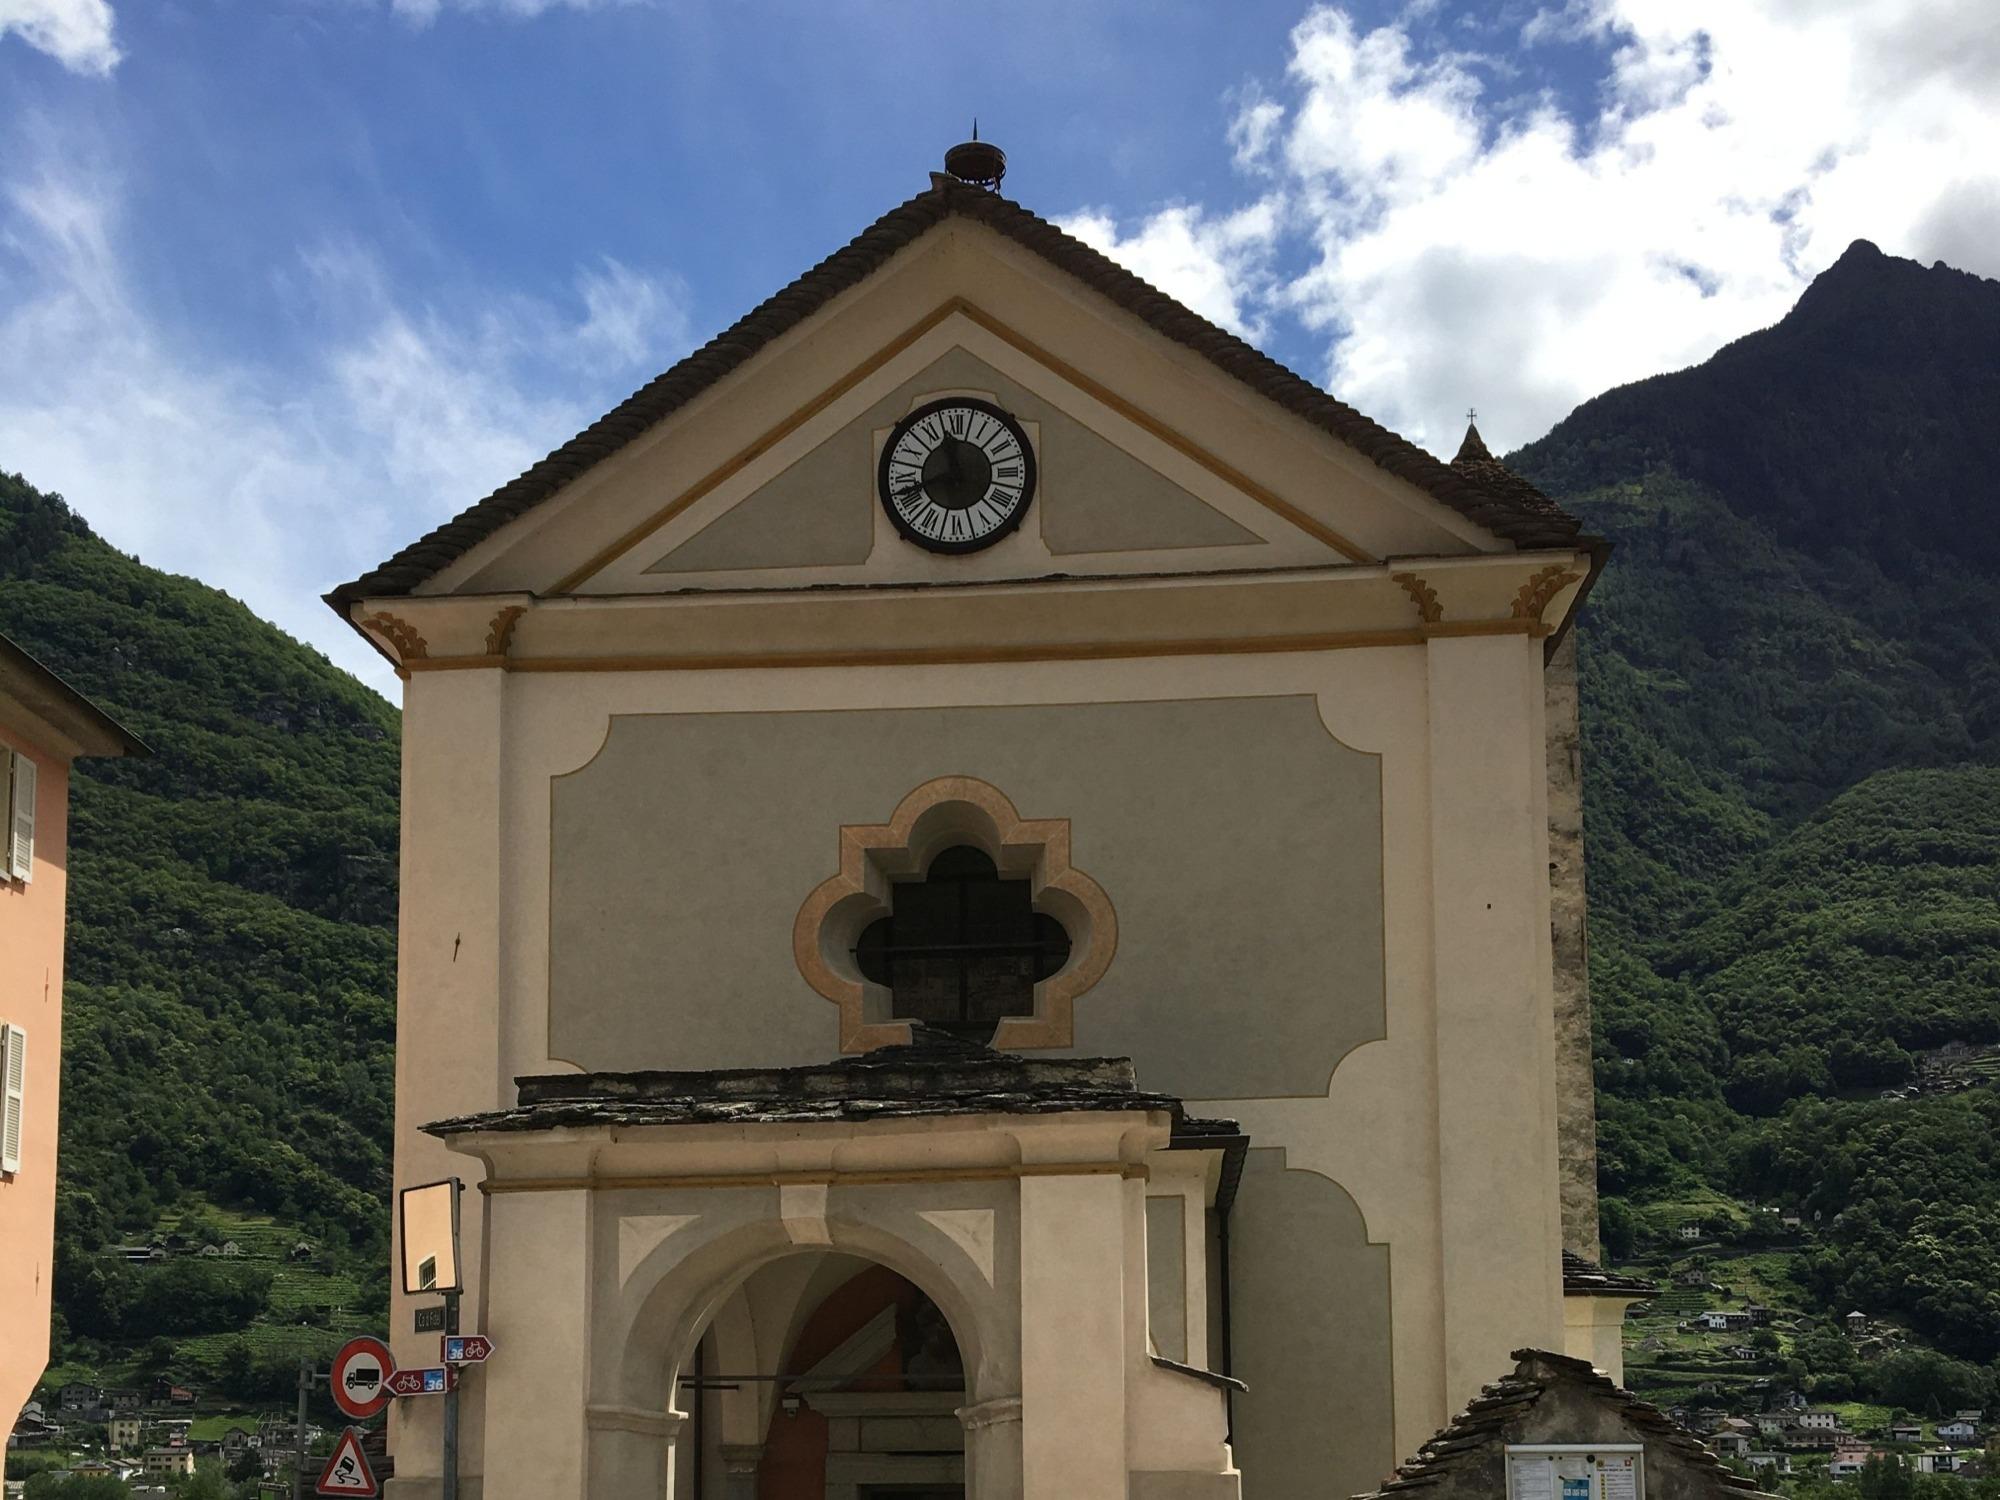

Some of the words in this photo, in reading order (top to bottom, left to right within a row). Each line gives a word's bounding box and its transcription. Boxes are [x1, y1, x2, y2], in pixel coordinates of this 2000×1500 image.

[997, 466, 1019, 478] III
[450, 1348, 463, 1360] 36
[427, 1379, 443, 1391] 36
